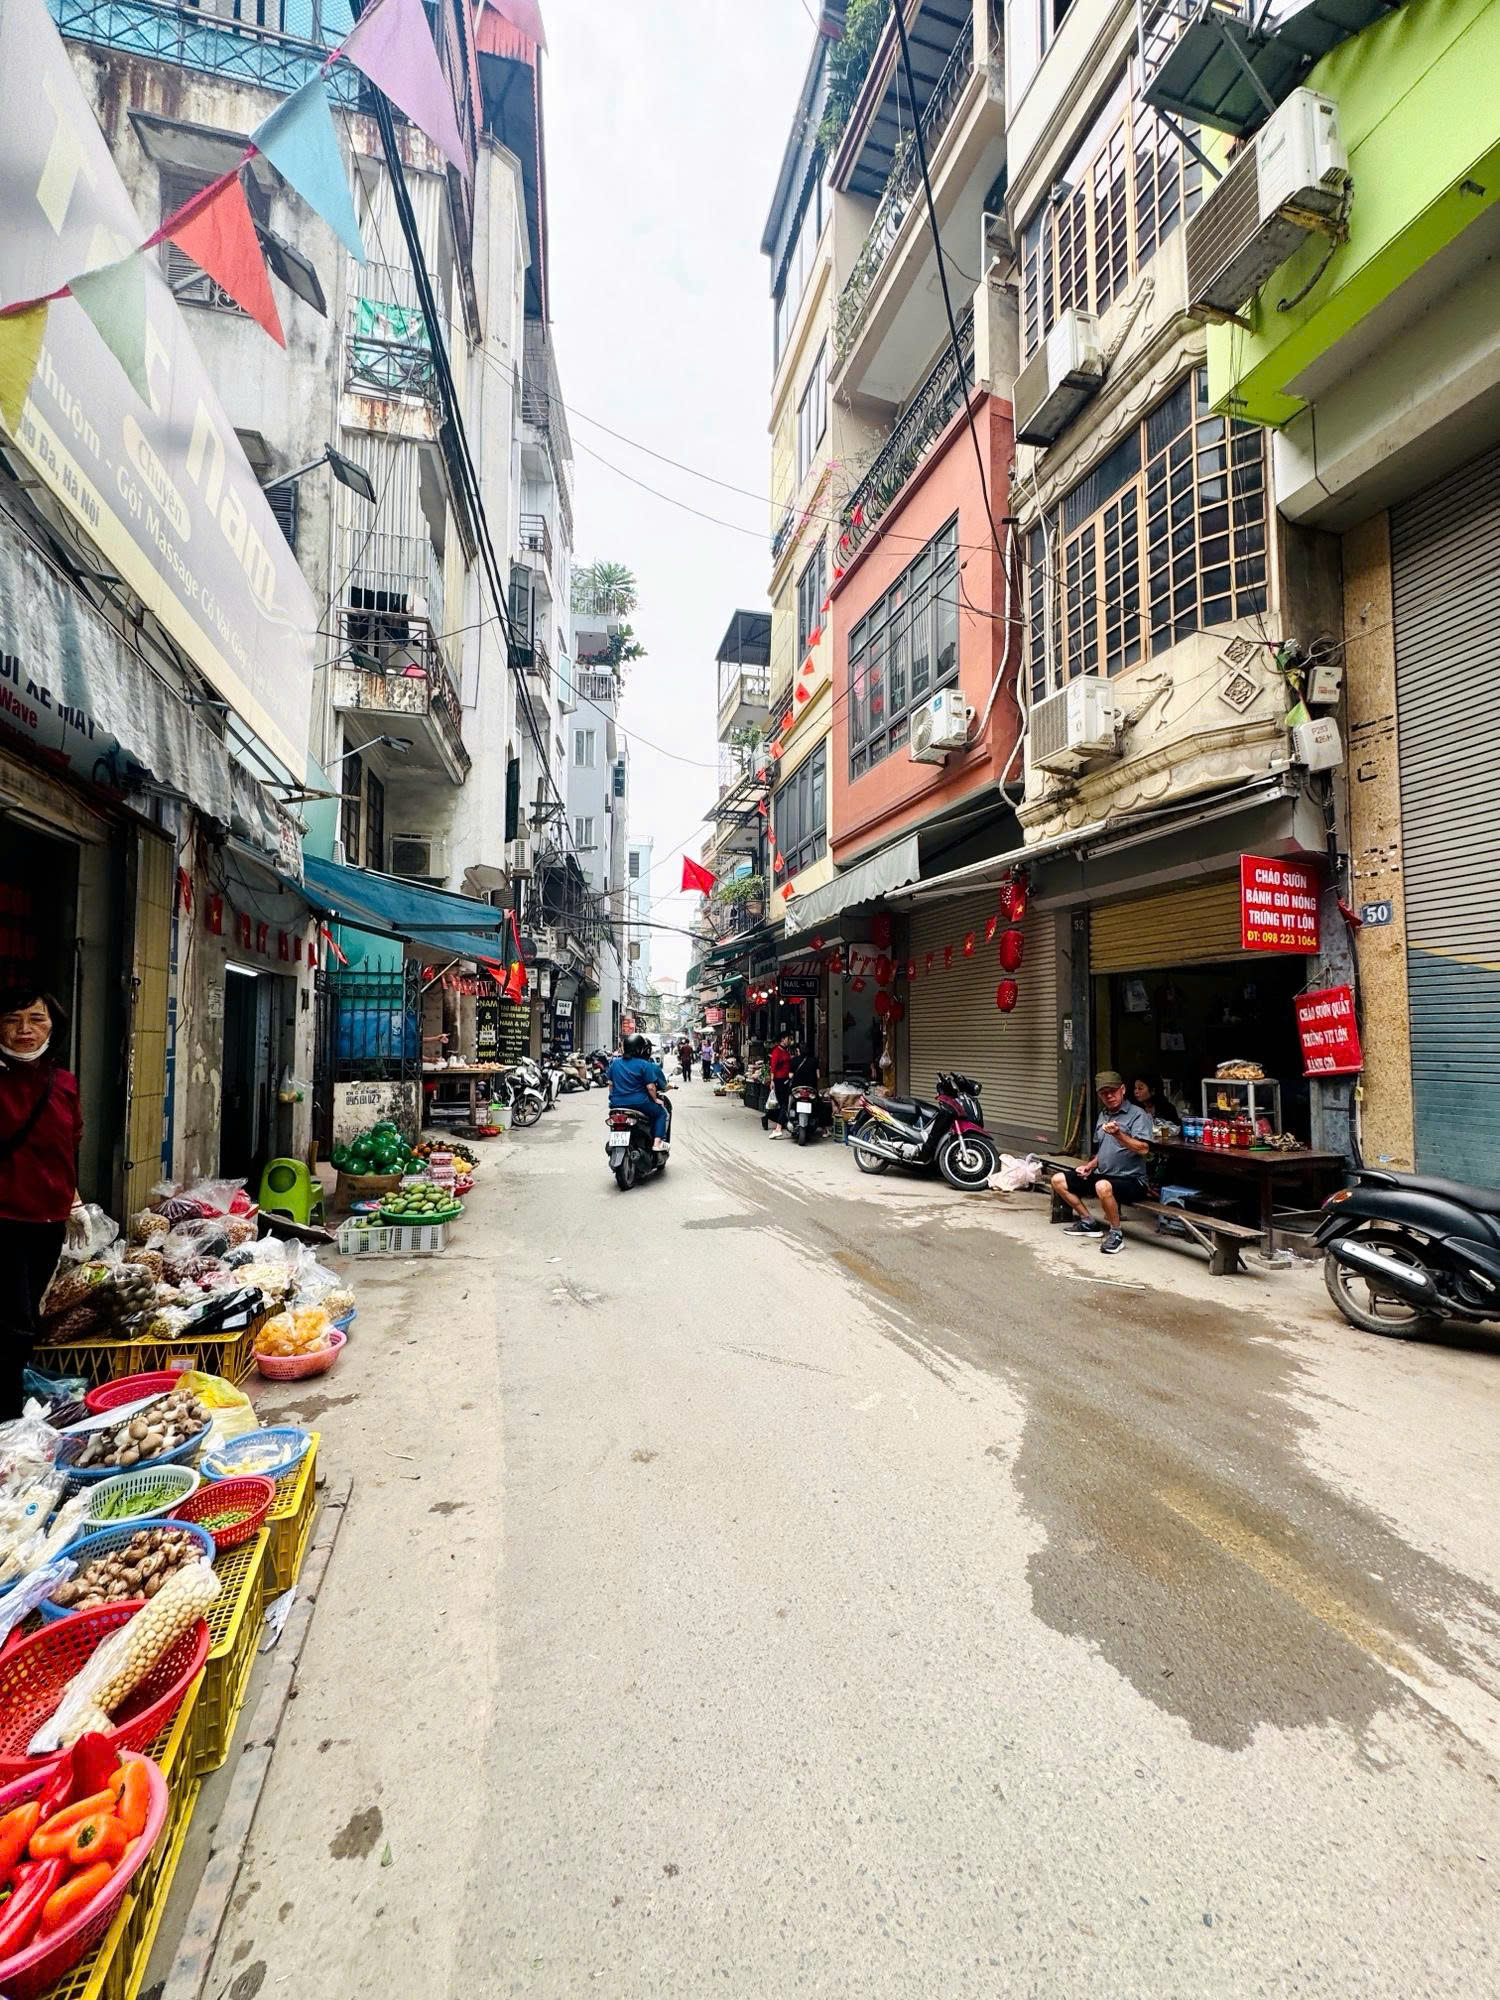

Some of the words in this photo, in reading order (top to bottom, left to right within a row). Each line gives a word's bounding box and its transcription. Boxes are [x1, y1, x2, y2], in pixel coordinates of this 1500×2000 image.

[63, 463, 78, 499] Hà
[81, 487, 100, 528] Nội
[138, 440, 184, 527] Chuyên
[117, 465, 143, 521] Gội
[146, 504, 198, 599] Massage
[216, 610, 230, 642] Vai
[1255, 868, 1280, 886] CHÁO
[1283, 871, 1307, 889] SƯỜN
[1245, 887, 1272, 905] BÁNH
[1274, 890, 1289, 908] GIÒ
[1291, 893, 1317, 911] NÓNG
[1249, 908, 1280, 927] TRỨNG
[1281, 913, 1296, 931] VỊT
[1297, 915, 1315, 933] LỘN
[1366, 905, 1388, 923] 50
[1247, 930, 1260, 942] ĐT:
[1262, 931, 1278, 943] 098
[1280, 933, 1295, 945] 223
[1297, 934, 1317, 946] 1064
